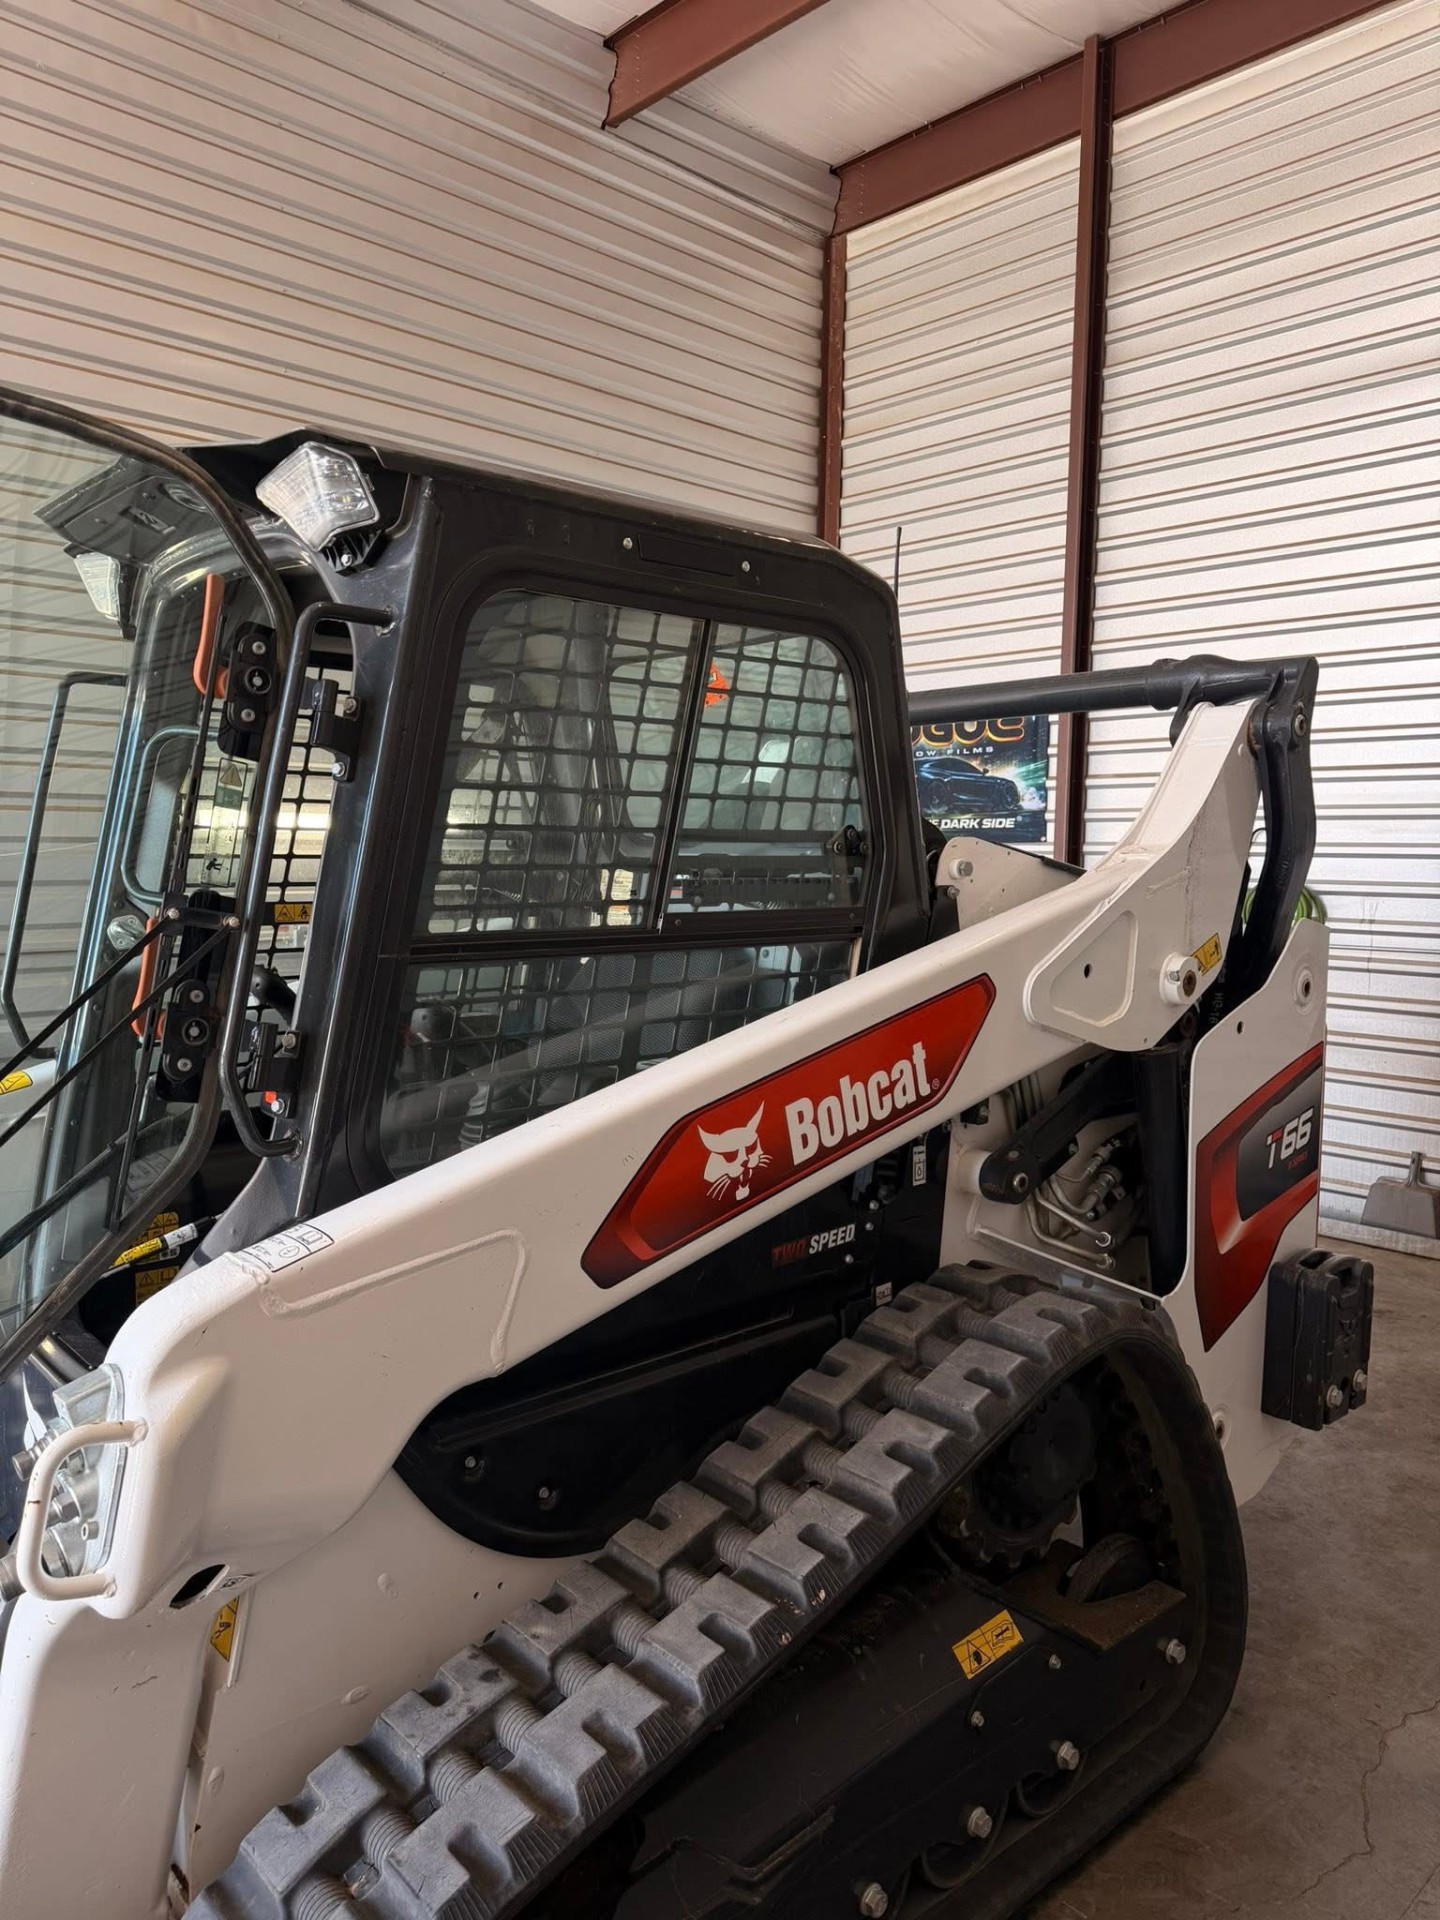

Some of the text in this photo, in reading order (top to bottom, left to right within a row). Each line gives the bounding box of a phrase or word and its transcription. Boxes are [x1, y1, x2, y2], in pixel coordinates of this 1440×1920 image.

[946, 746, 994, 755] FILMS
[940, 818, 981, 829] DARK
[981, 817, 1016, 828] SIDE
[785, 1041, 931, 1166] Bobcat
[1266, 1108, 1314, 1169] T66
[772, 1224, 856, 1264] TWO SPEED
